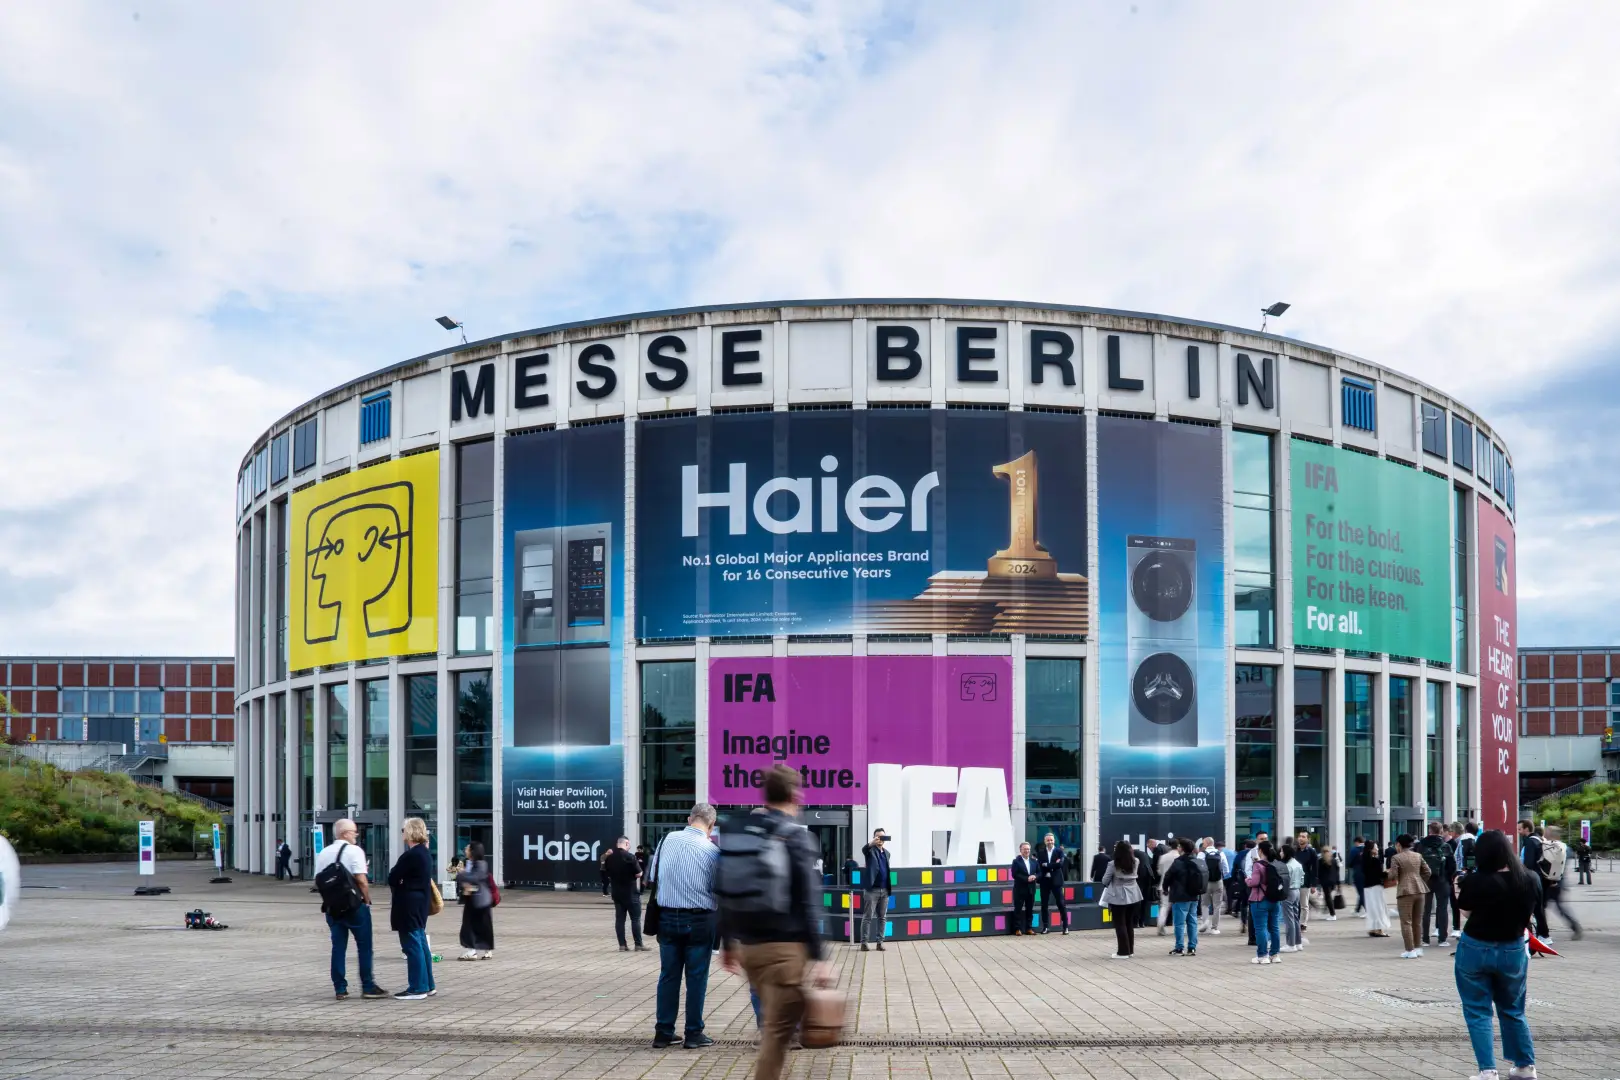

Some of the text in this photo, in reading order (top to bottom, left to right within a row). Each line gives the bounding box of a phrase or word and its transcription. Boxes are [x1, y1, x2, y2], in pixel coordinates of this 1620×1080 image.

[451, 325, 1274, 421] MESSE BERLIN
[1016, 470, 1026, 496] NO.1
[1305, 461, 1339, 493] IFA
[682, 455, 940, 537] Haier
[1306, 513, 1404, 554] For the bold.
[682, 549, 930, 567] No.1 Global Major Appliances Brand
[1007, 564, 1038, 574] 2024
[1306, 544, 1424, 587] For the curious.
[722, 566, 892, 581] for 16 Consecutive Years
[1306, 575, 1409, 612] For the keen.
[1306, 606, 1363, 635] For all.
[1493, 614, 1510, 647] THE
[1488, 647, 1514, 681] HEART
[724, 673, 777, 703] IFA
[1498, 682, 1509, 711] OF
[1492, 716, 1513, 744] YOUR
[723, 729, 830, 761] Imagine
[1498, 747, 1510, 774] PC
[723, 764, 861, 789] the ture.
[1116, 784, 1210, 797] Visit Haier Pavilion,
[517, 786, 607, 799] Visit Haier Pavilion,
[517, 800, 535, 809] Hall
[537, 800, 549, 809] 3.1
[557, 799, 586, 809] Booth
[588, 799, 608, 809] 101.
[1116, 797, 1136, 808] Hall
[1138, 797, 1152, 808] 3.1
[1161, 797, 1189, 808] Booth
[1191, 797, 1211, 809] 101.
[867, 763, 1015, 867] IFA
[523, 834, 600, 861] Haier
